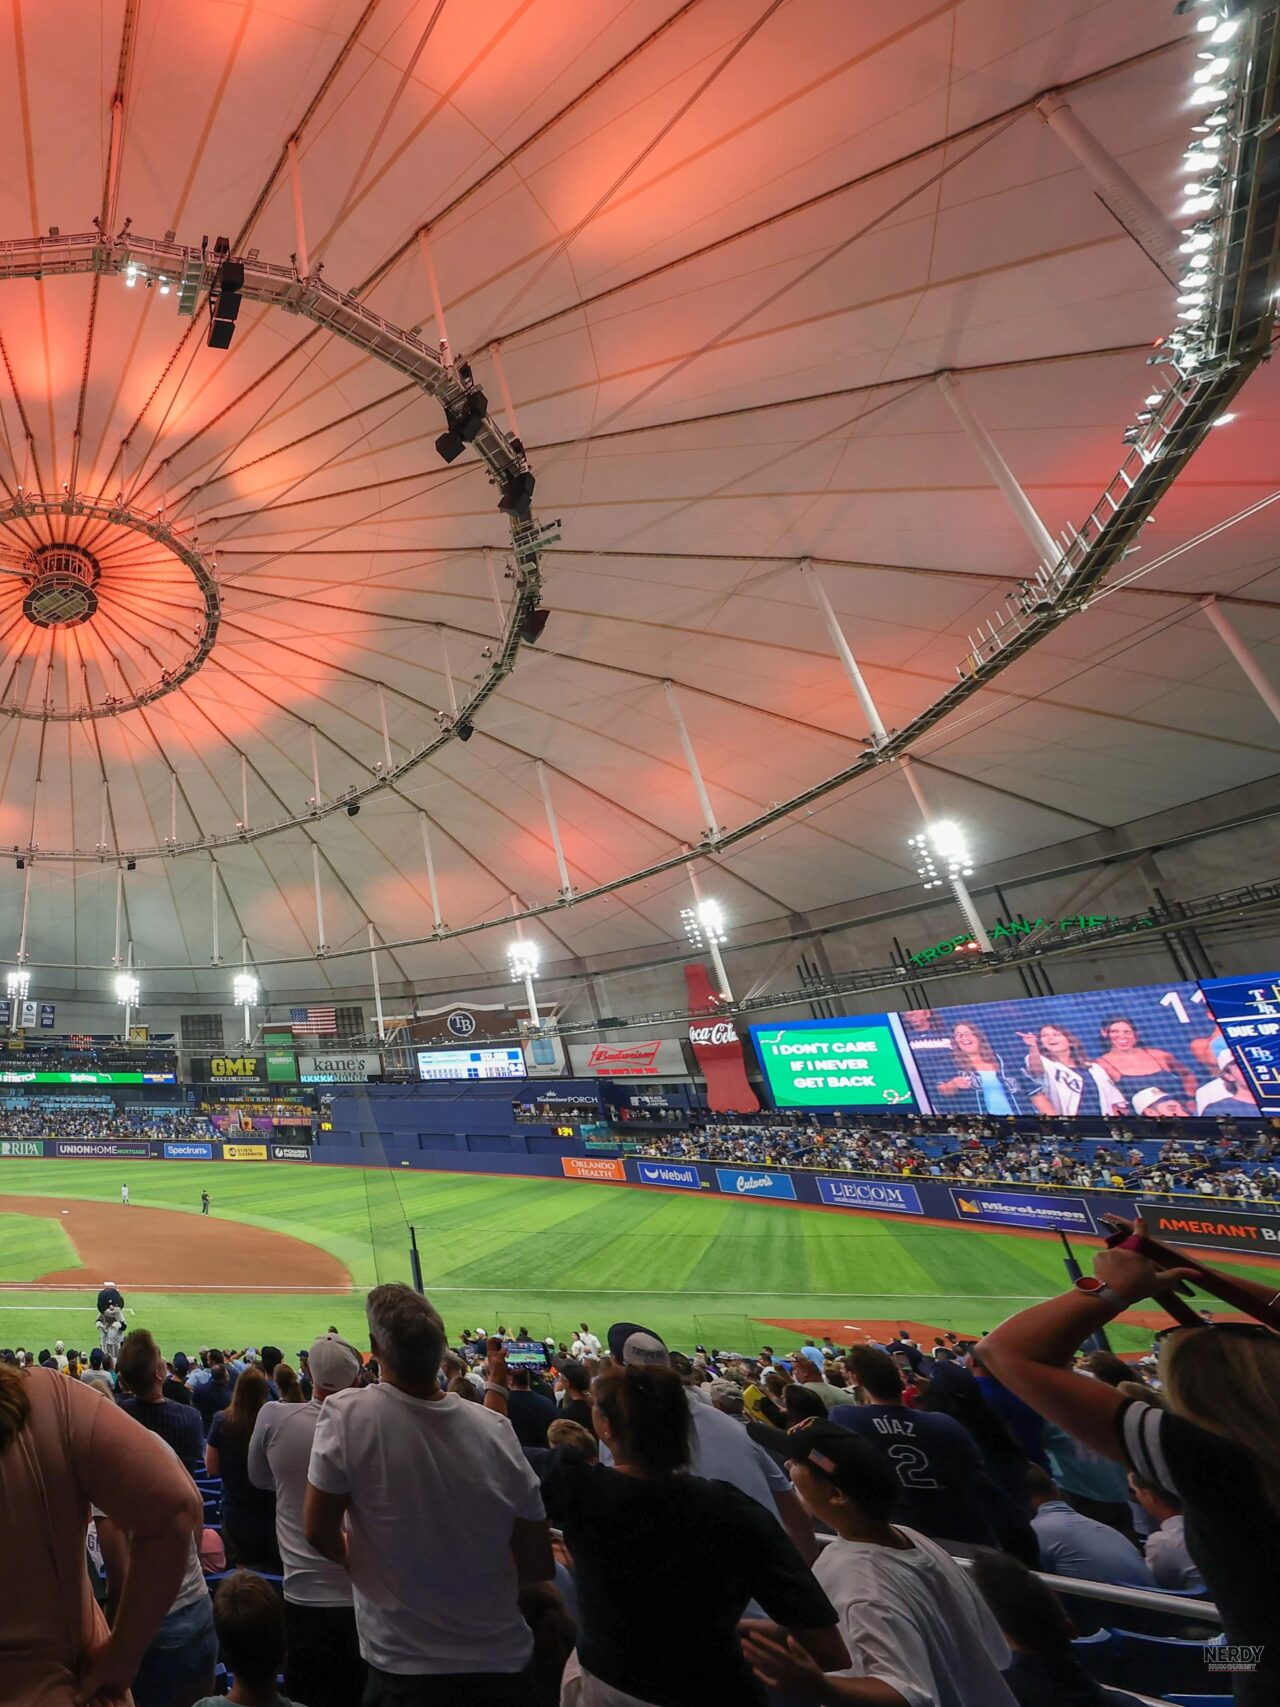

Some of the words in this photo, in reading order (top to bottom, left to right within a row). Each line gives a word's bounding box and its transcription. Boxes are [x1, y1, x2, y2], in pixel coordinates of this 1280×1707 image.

[1226, 1025, 1258, 1037] DUE
[771, 1045, 779, 1055] I
[780, 1043, 829, 1055] DON'T
[831, 1041, 878, 1053] CARE
[211, 1058, 257, 1076] GMF
[312, 1057, 365, 1071] kane's
[790, 1061, 804, 1072] IF
[807, 1061, 814, 1071] I
[814, 1059, 869, 1071] NEVER
[793, 1078, 825, 1089] GET
[827, 1076, 876, 1088] BACK
[567, 1096, 598, 1104] PORCH
[11, 1142, 39, 1155] RIPA
[167, 1145, 204, 1156] Spectrum
[570, 1159, 616, 1170] ORLANDO
[577, 1168, 613, 1178] HEALTH
[660, 1168, 694, 1183] Webull
[736, 1174, 774, 1192] Culver's
[981, 1201, 1085, 1219] MicroLumen
[1159, 1217, 1258, 1240] AMERANT
[872, 1415, 916, 1437] DÍAZ
[888, 1444, 938, 1488] 2
